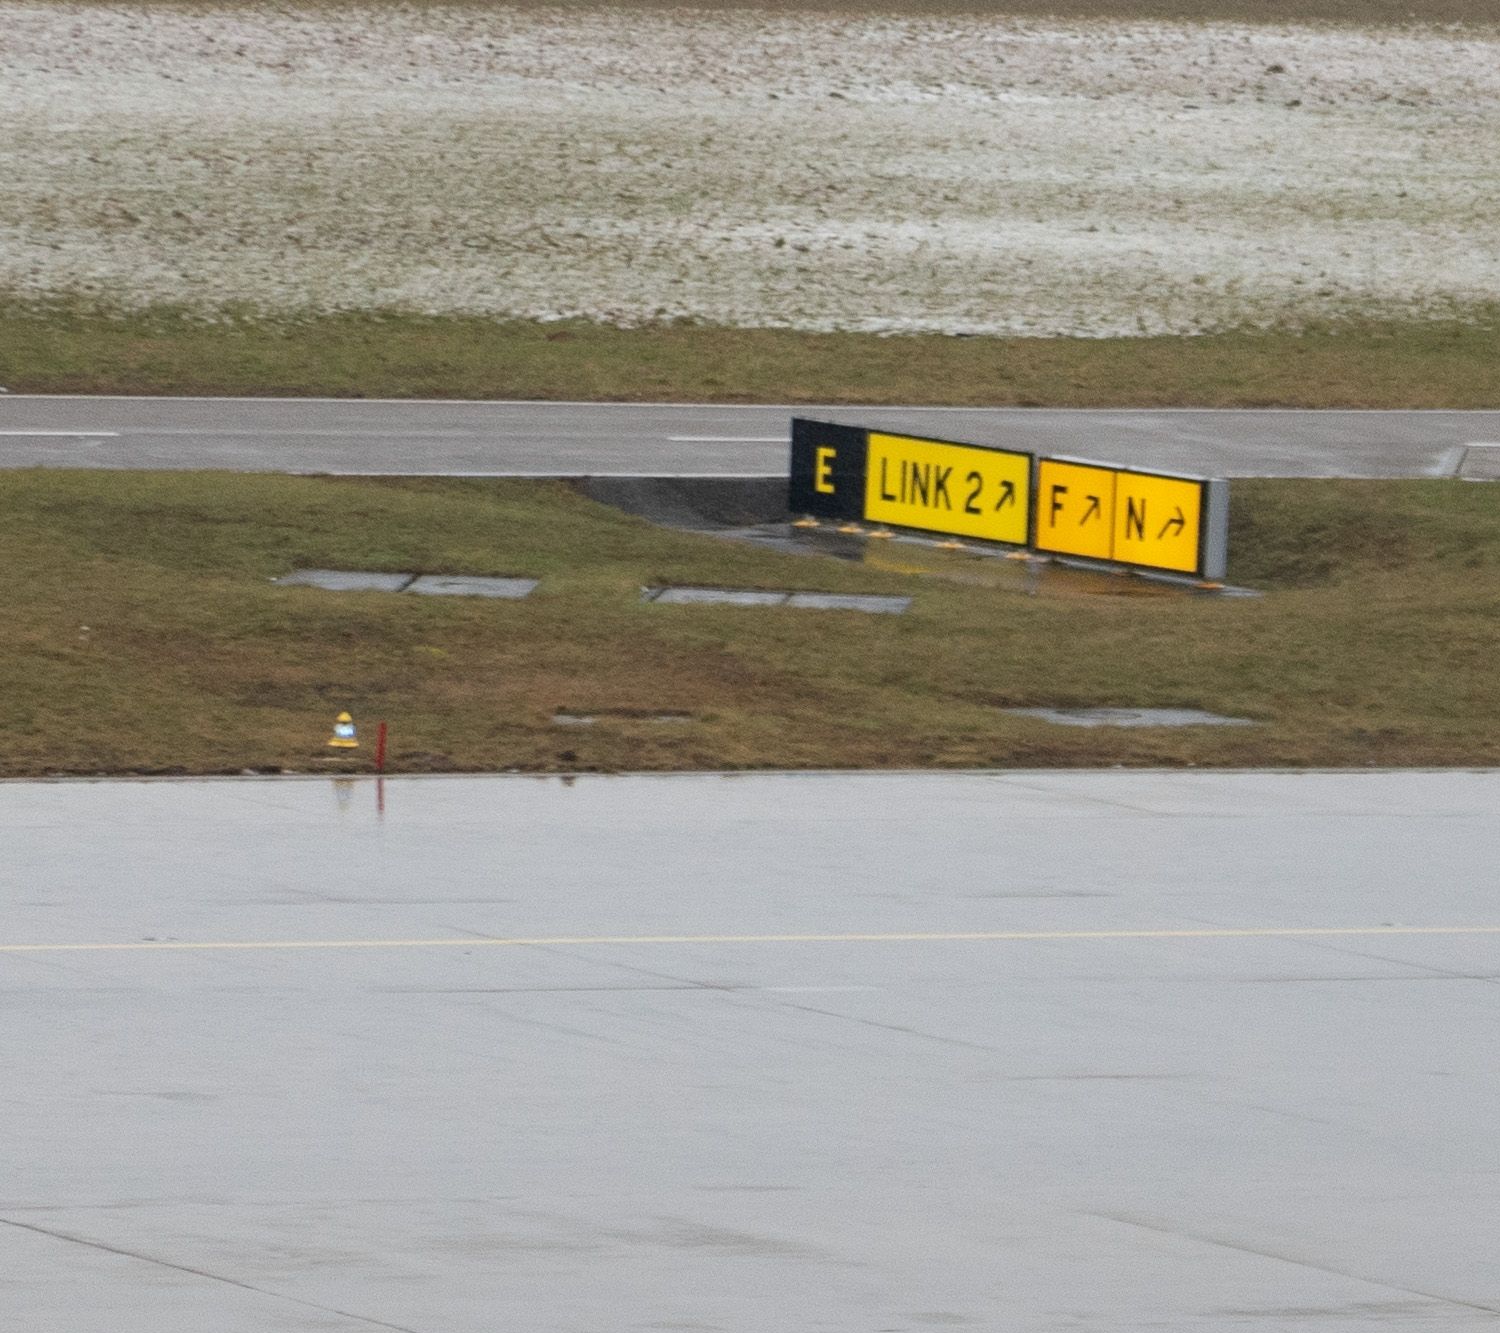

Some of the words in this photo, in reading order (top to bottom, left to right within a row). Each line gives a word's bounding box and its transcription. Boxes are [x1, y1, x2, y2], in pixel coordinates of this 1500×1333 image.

[814, 447, 837, 495] E
[879, 456, 954, 511] LINK
[964, 470, 983, 515] 2
[1049, 484, 1068, 529] F
[1125, 496, 1146, 542] N
